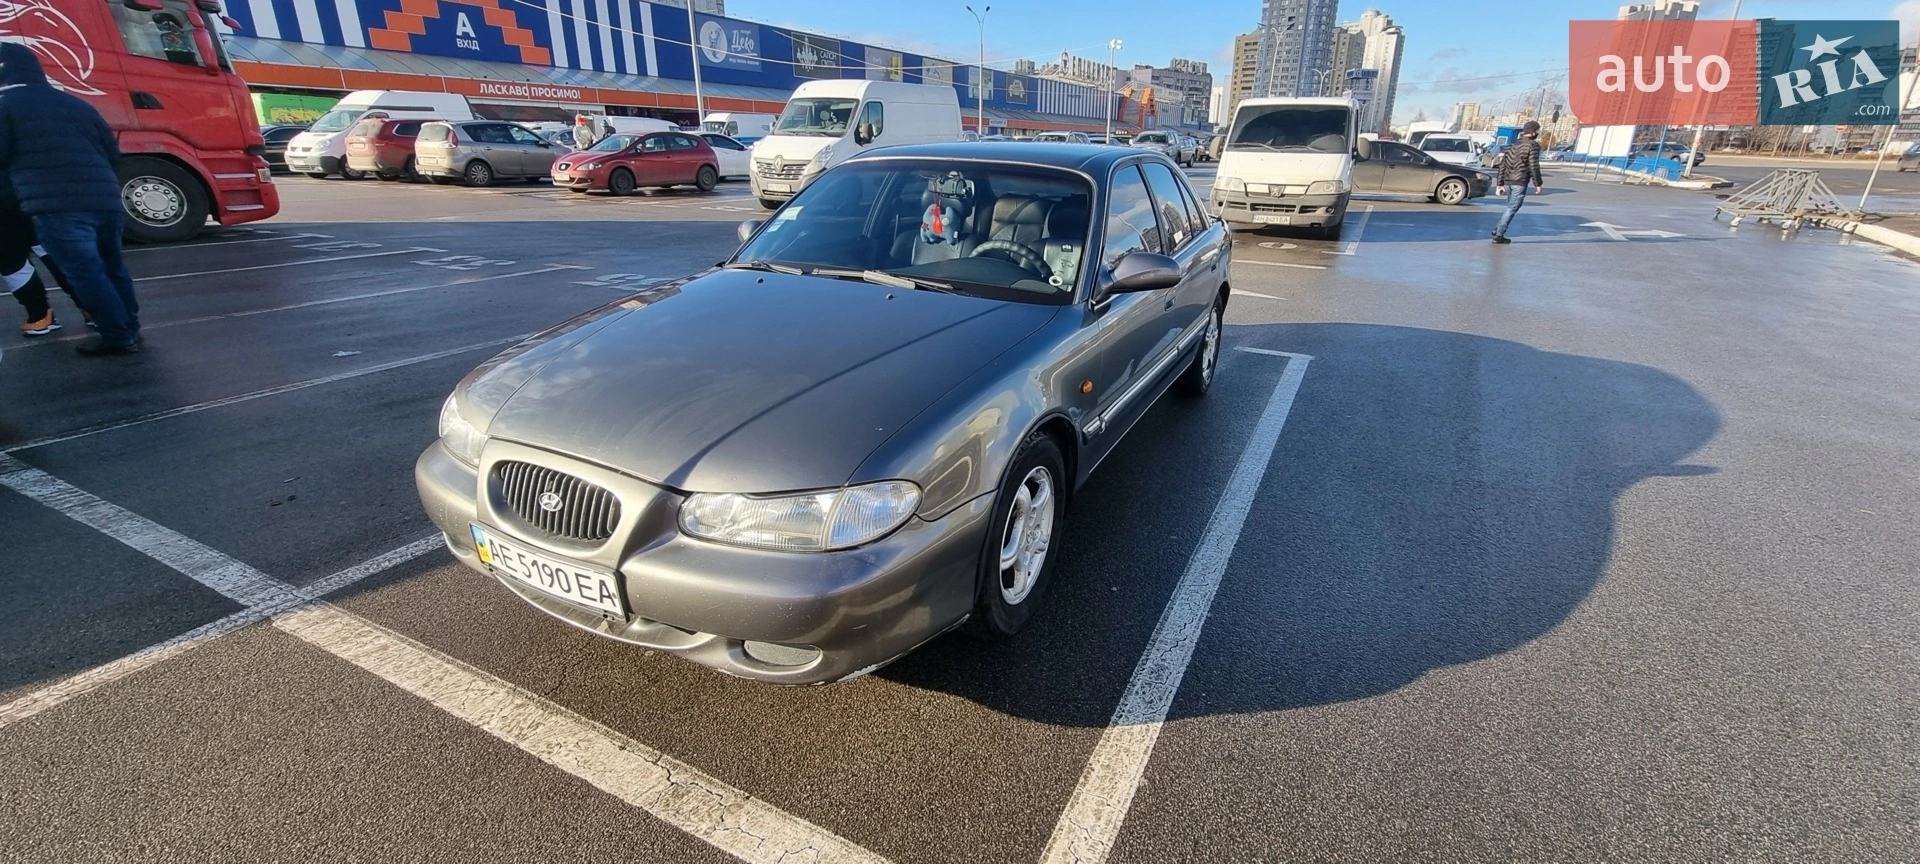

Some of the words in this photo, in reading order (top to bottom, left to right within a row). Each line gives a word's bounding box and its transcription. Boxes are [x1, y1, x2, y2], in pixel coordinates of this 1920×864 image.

[456, 11, 476, 38] А
[456, 38, 480, 51] ВХІД
[731, 29, 755, 53] Деко
[480, 83, 529, 97] ЛАСКАВО
[531, 86, 581, 99] ПРОСИМО!
[489, 539, 517, 573] AE
[517, 552, 572, 594] 5190
[575, 572, 617, 607] EA
